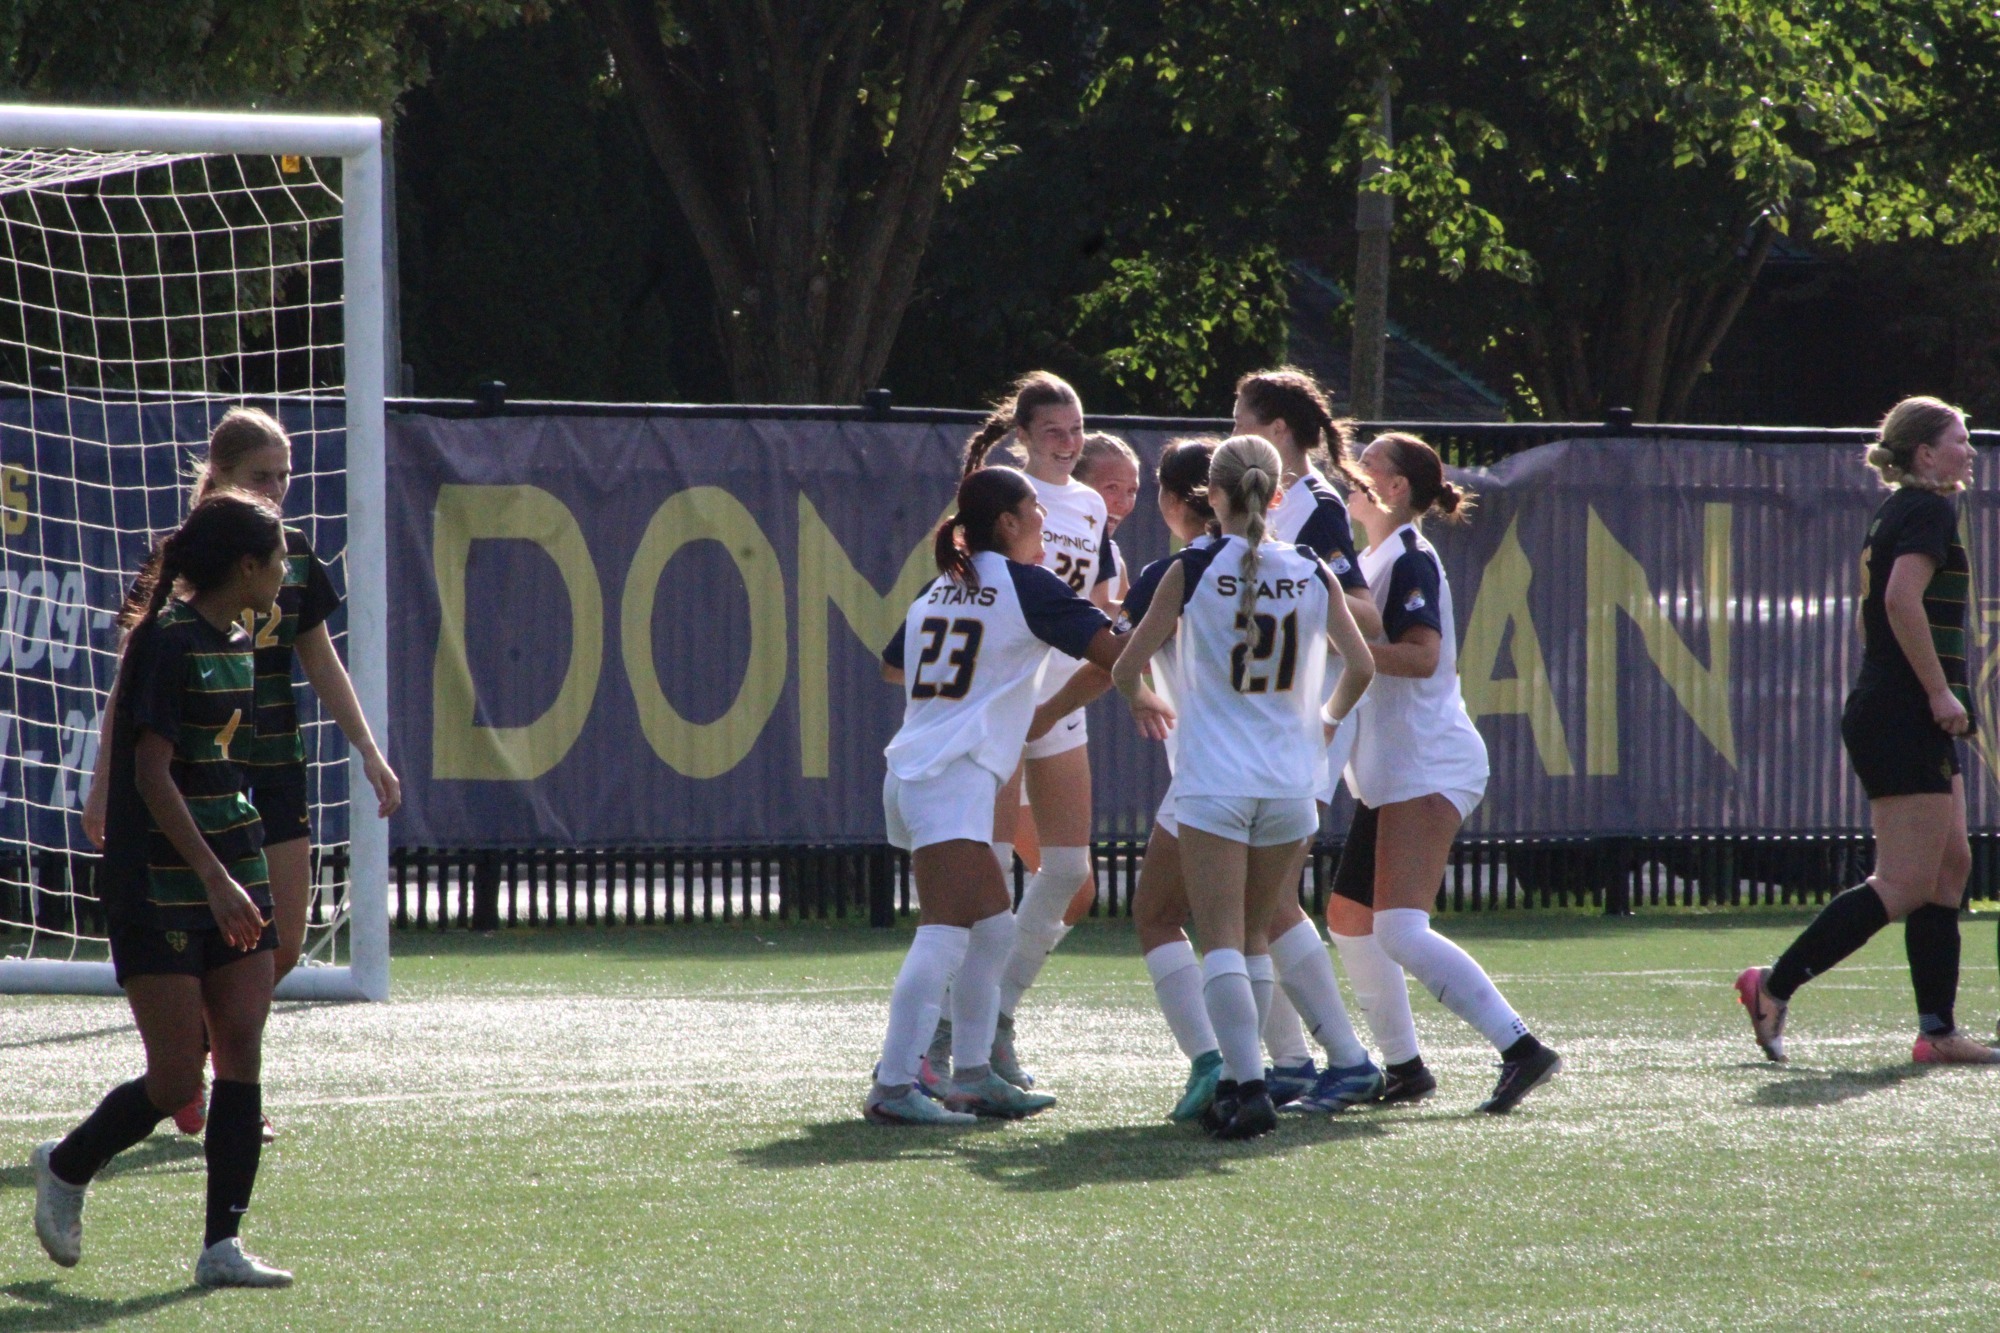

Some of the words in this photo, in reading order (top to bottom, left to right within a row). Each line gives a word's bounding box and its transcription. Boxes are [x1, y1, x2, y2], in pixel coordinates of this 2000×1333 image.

[927, 585, 998, 607] STARS
[911, 616, 984, 701] 23
[1229, 607, 1298, 694] 21
